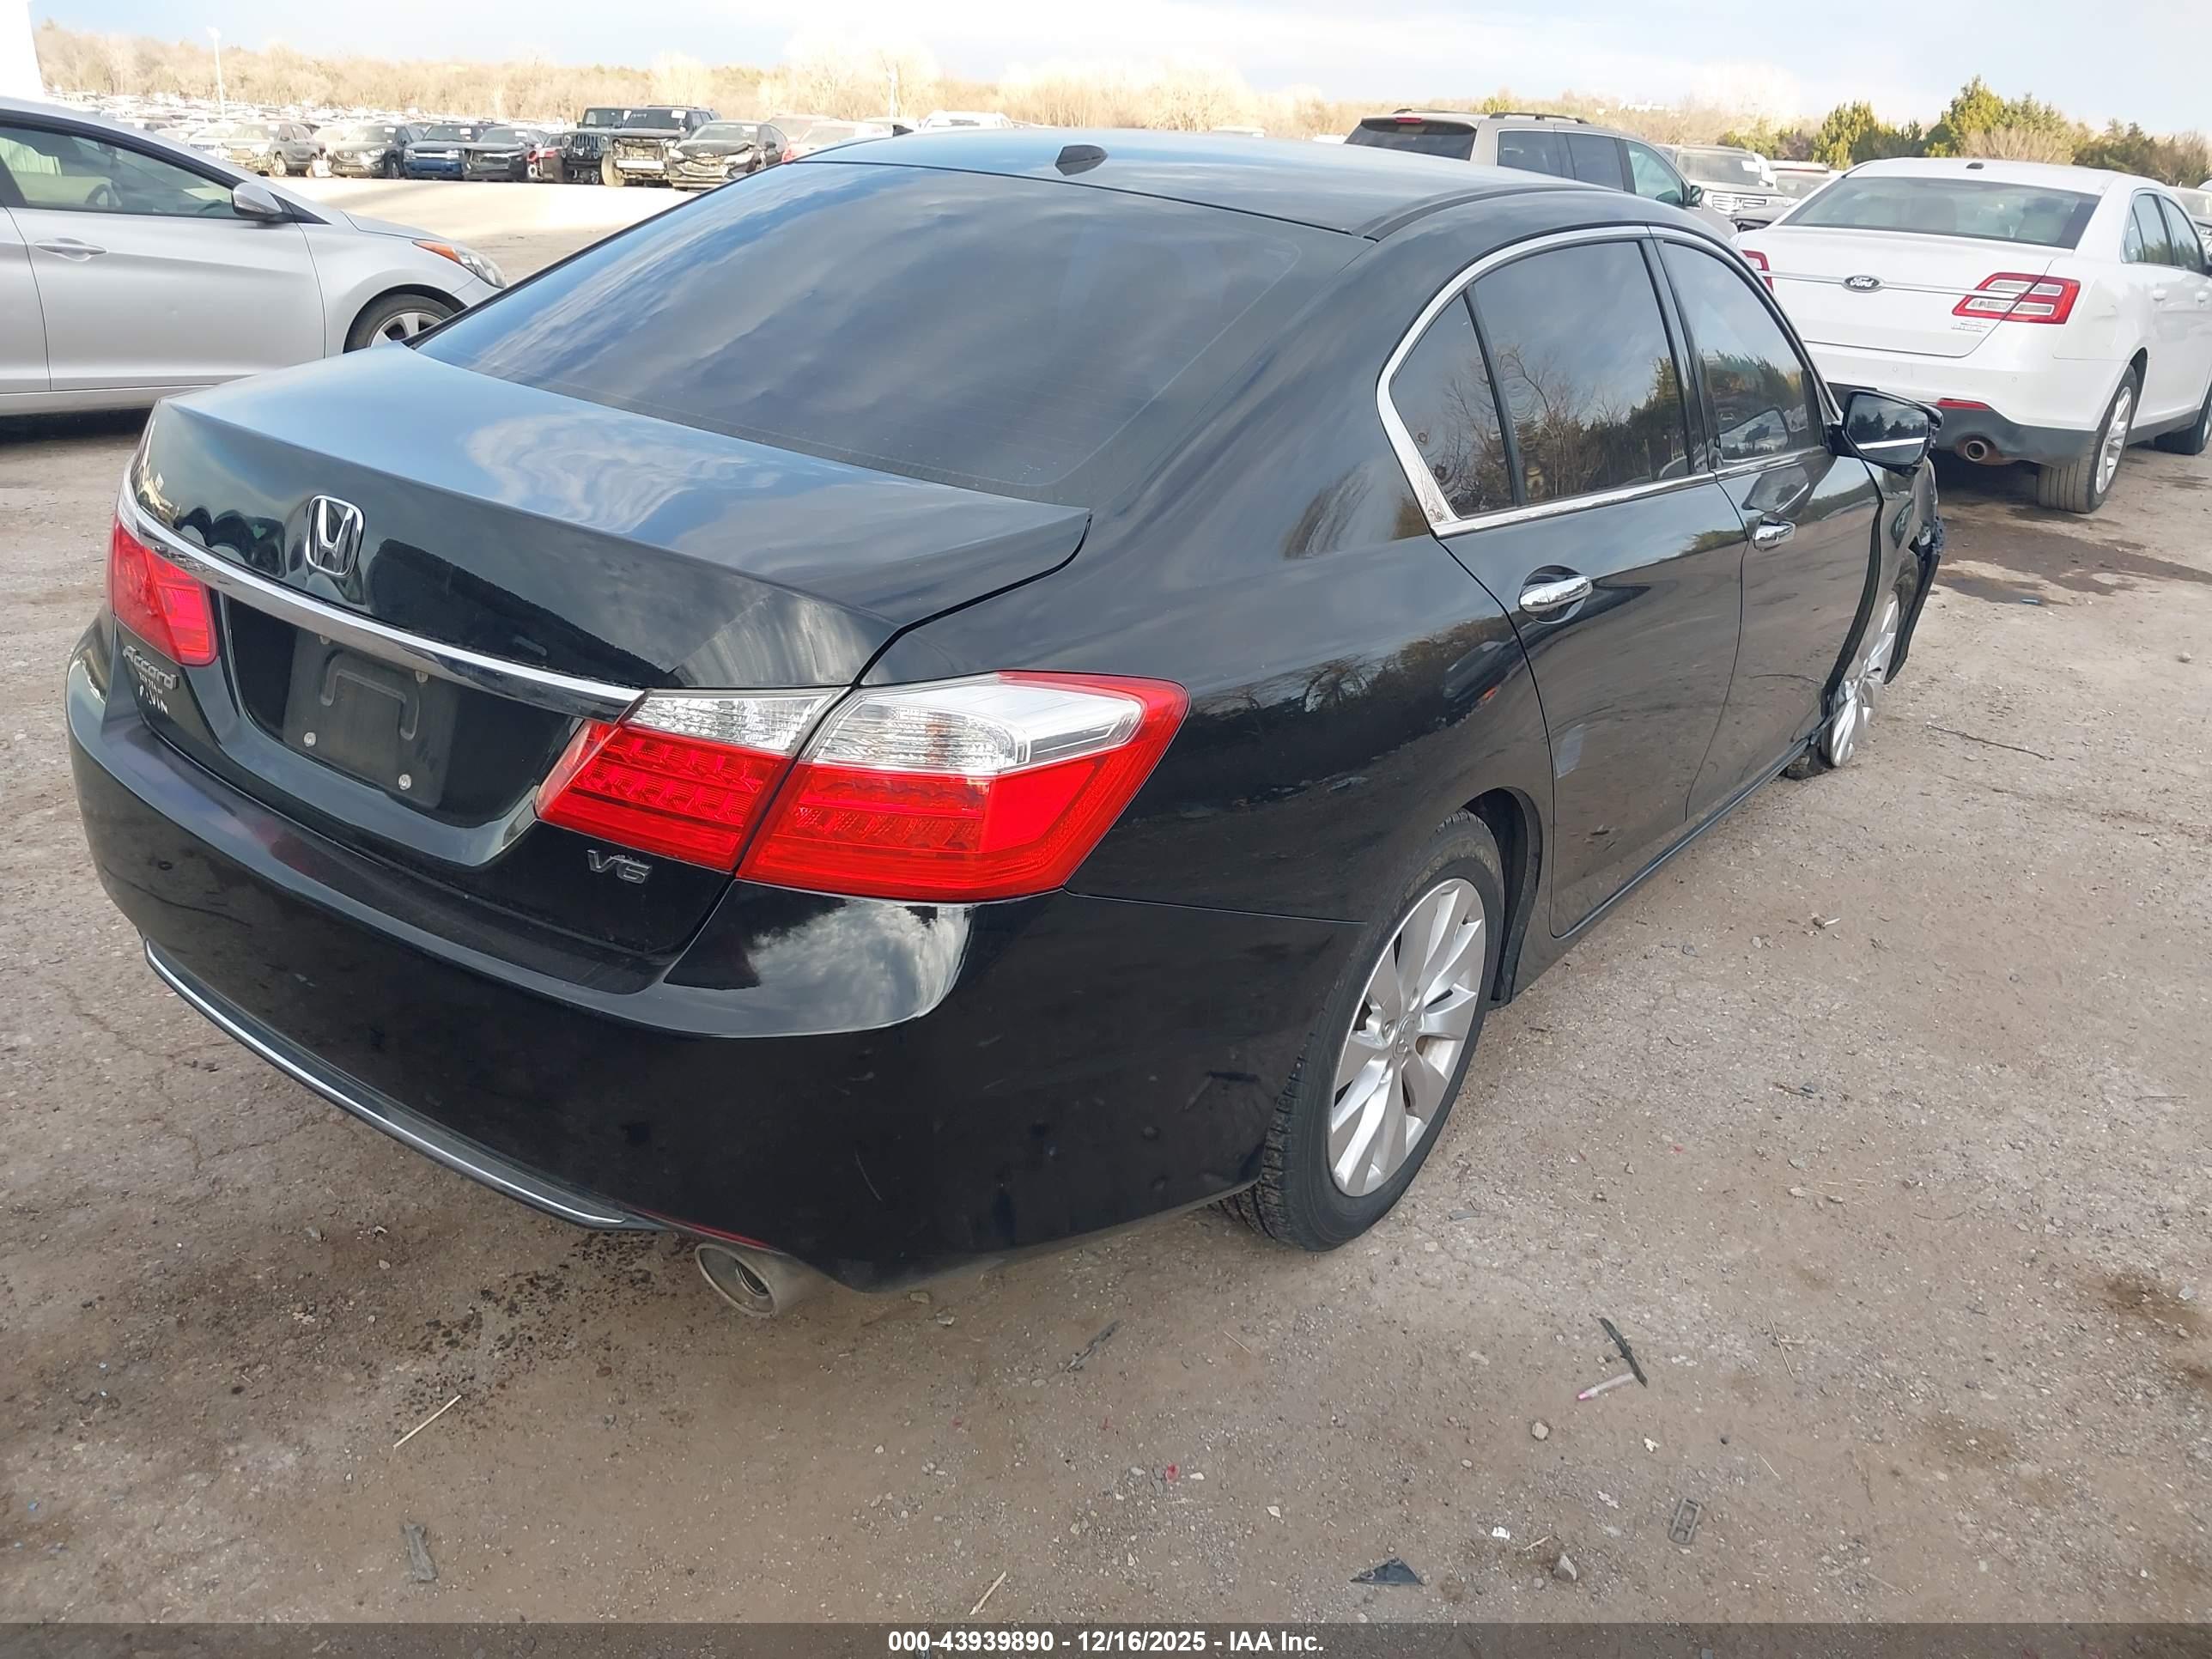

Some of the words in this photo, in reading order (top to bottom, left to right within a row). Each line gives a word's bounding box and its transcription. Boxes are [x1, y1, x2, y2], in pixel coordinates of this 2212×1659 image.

[1849, 276, 1875, 288] Ford
[122, 645, 177, 690] Accord
[586, 849, 652, 884] V6
